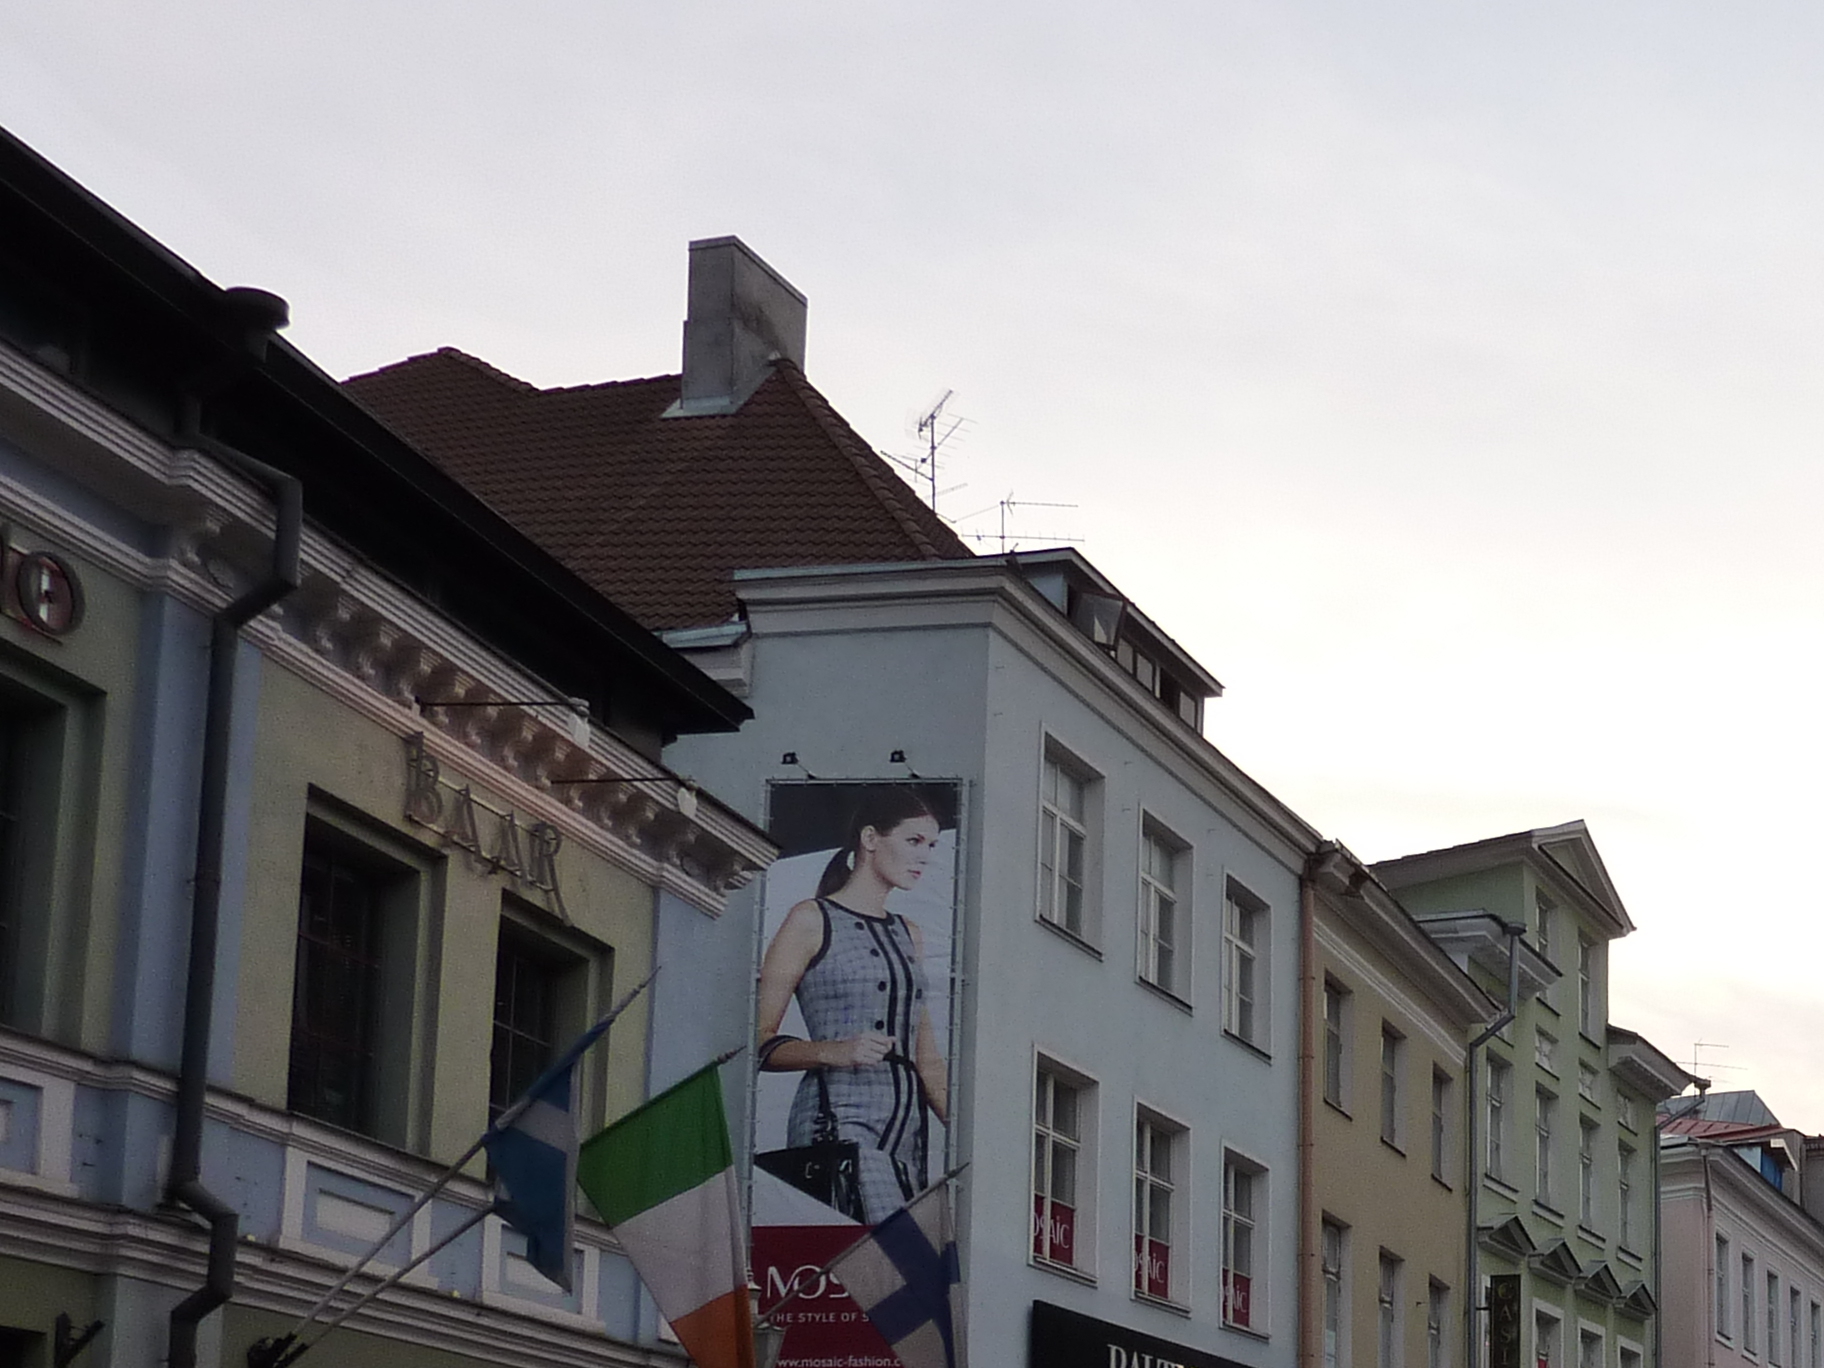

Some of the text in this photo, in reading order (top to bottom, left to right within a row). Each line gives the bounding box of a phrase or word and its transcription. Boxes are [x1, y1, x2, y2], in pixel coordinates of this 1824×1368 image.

[404, 731, 575, 927] BAAR
[798, 1312, 836, 1323] STYLE
[841, 1312, 857, 1322] OF
